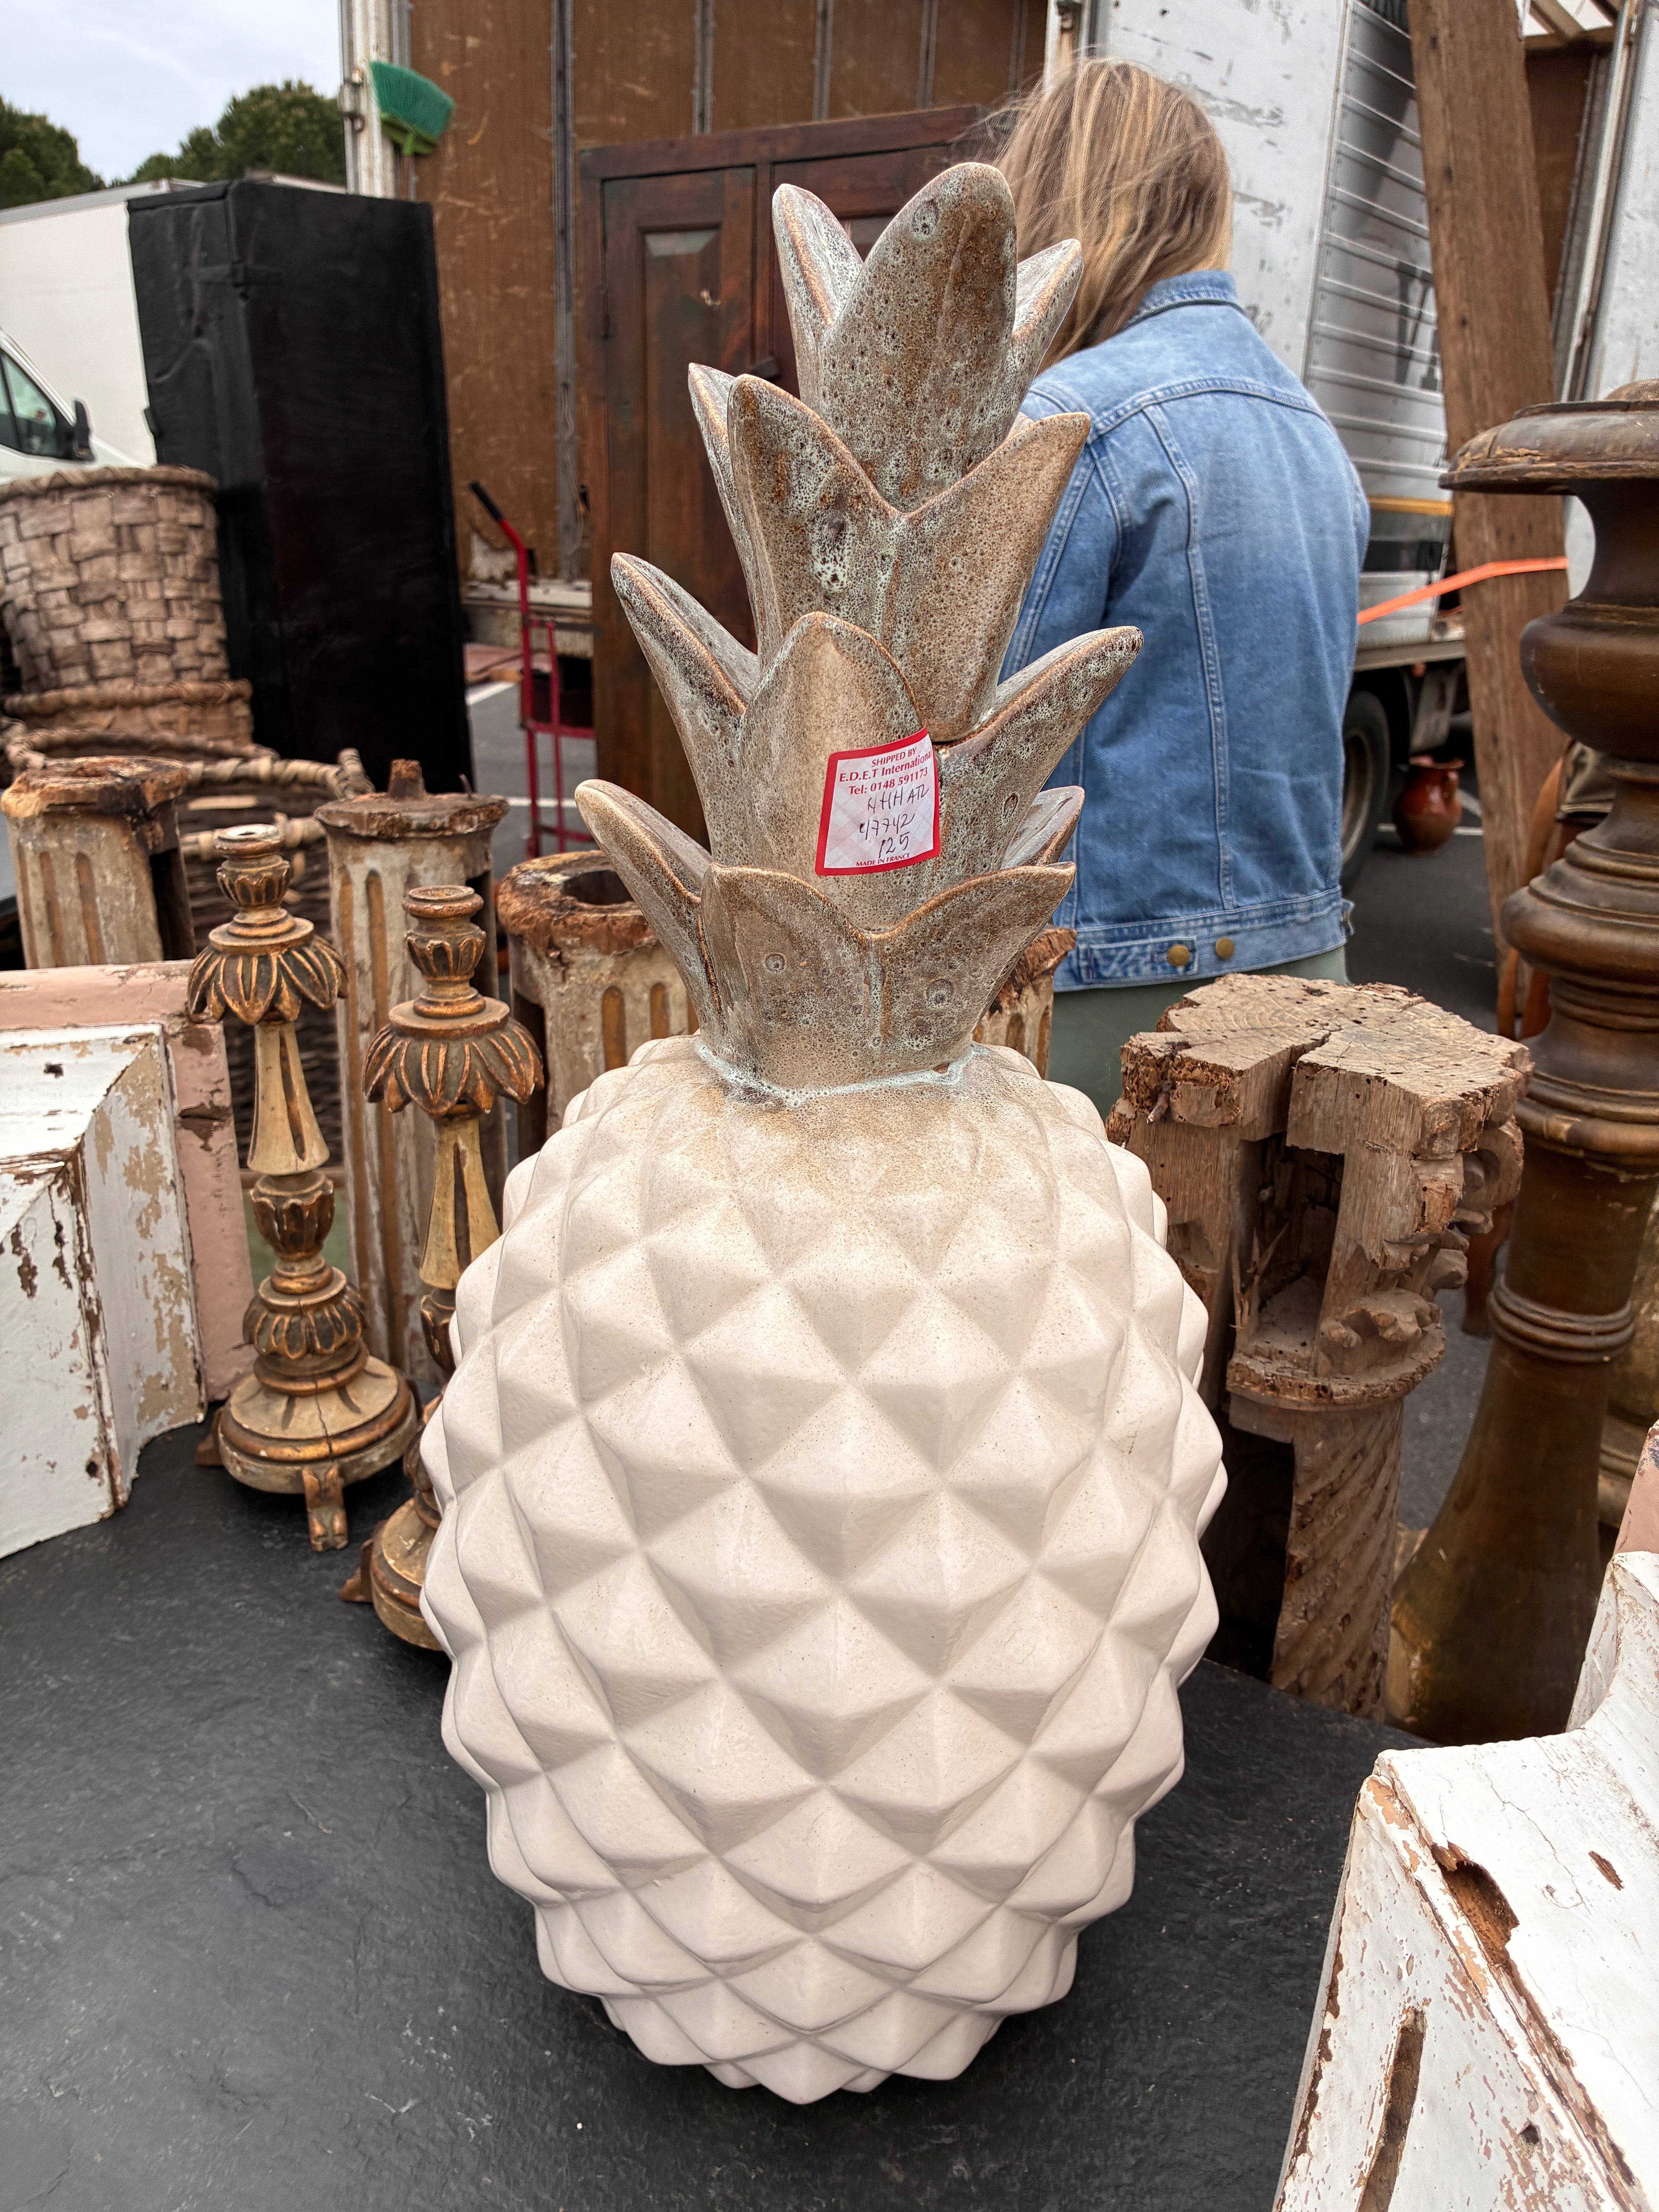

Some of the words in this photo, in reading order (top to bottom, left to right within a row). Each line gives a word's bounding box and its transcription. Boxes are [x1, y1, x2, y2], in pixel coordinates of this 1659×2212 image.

[839, 768, 879, 782] E.D.E.T
[881, 747, 932, 776] International
[871, 751, 906, 768] SHIPPED
[908, 747, 917, 757] BY
[848, 785, 867, 795] Tel:
[871, 779, 895, 792] 0148
[898, 767, 927, 786] 591173
[879, 831, 910, 859] 125
[886, 852, 910, 862] FRANCE
